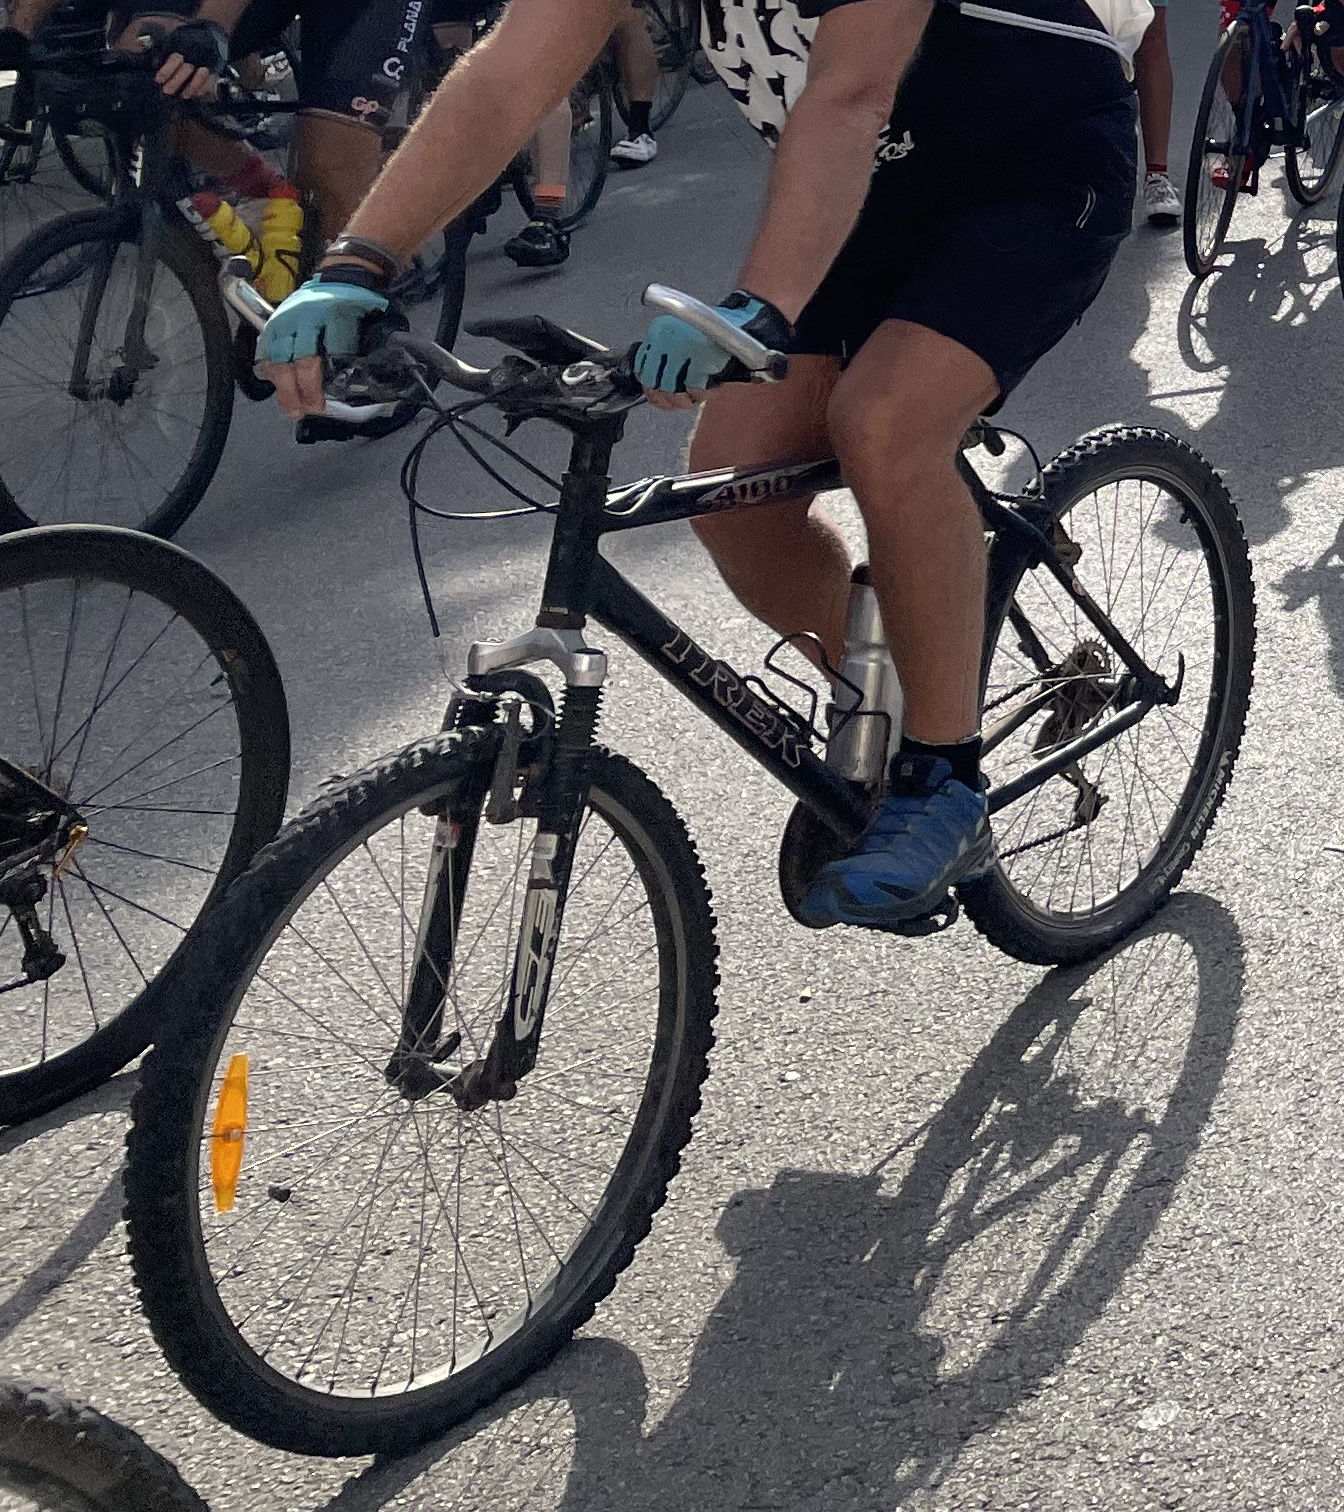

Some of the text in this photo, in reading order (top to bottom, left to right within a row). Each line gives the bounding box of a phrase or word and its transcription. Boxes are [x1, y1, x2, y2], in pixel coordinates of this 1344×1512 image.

[397, 0, 422, 53] PLANA
[660, 625, 811, 769] TREK
[1189, 766, 1227, 840] MICHELIN
